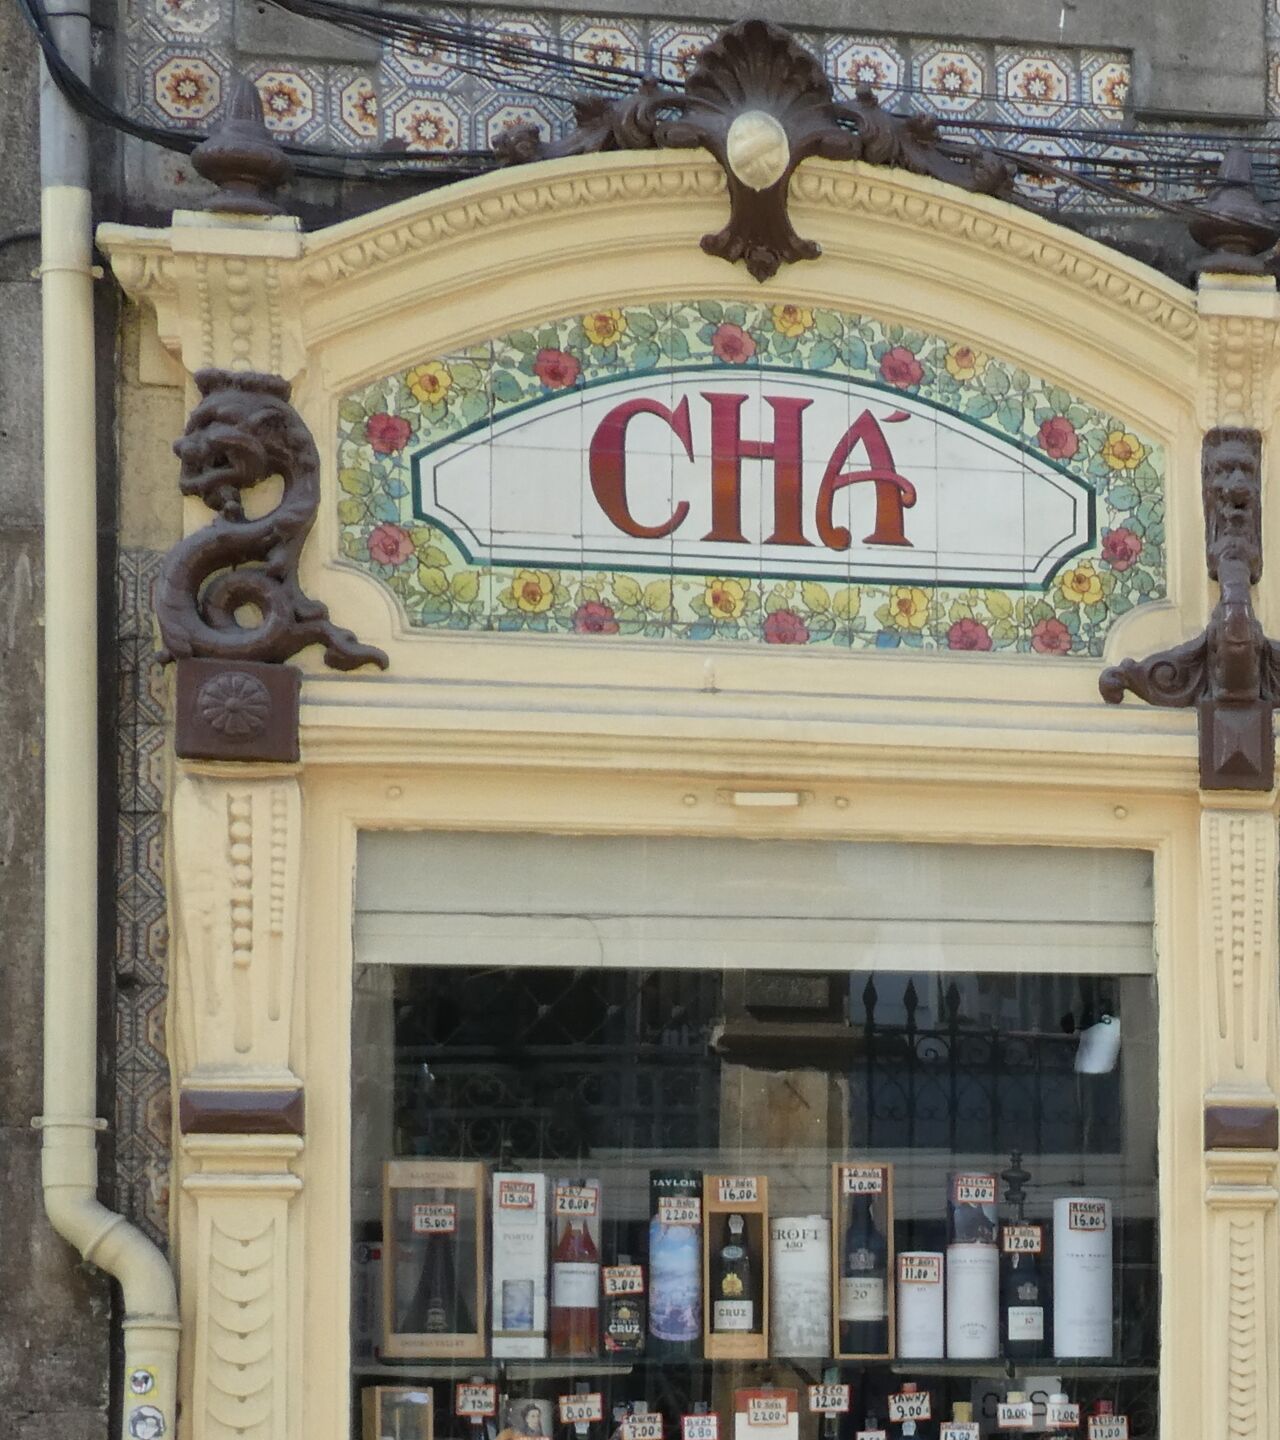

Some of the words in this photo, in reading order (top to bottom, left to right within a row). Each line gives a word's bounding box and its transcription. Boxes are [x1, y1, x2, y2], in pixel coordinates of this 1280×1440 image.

[588, 390, 918, 552] CHÁ
[608, 1323, 641, 1334] CRUZ
[892, 1394, 928, 1404] TAWNY
